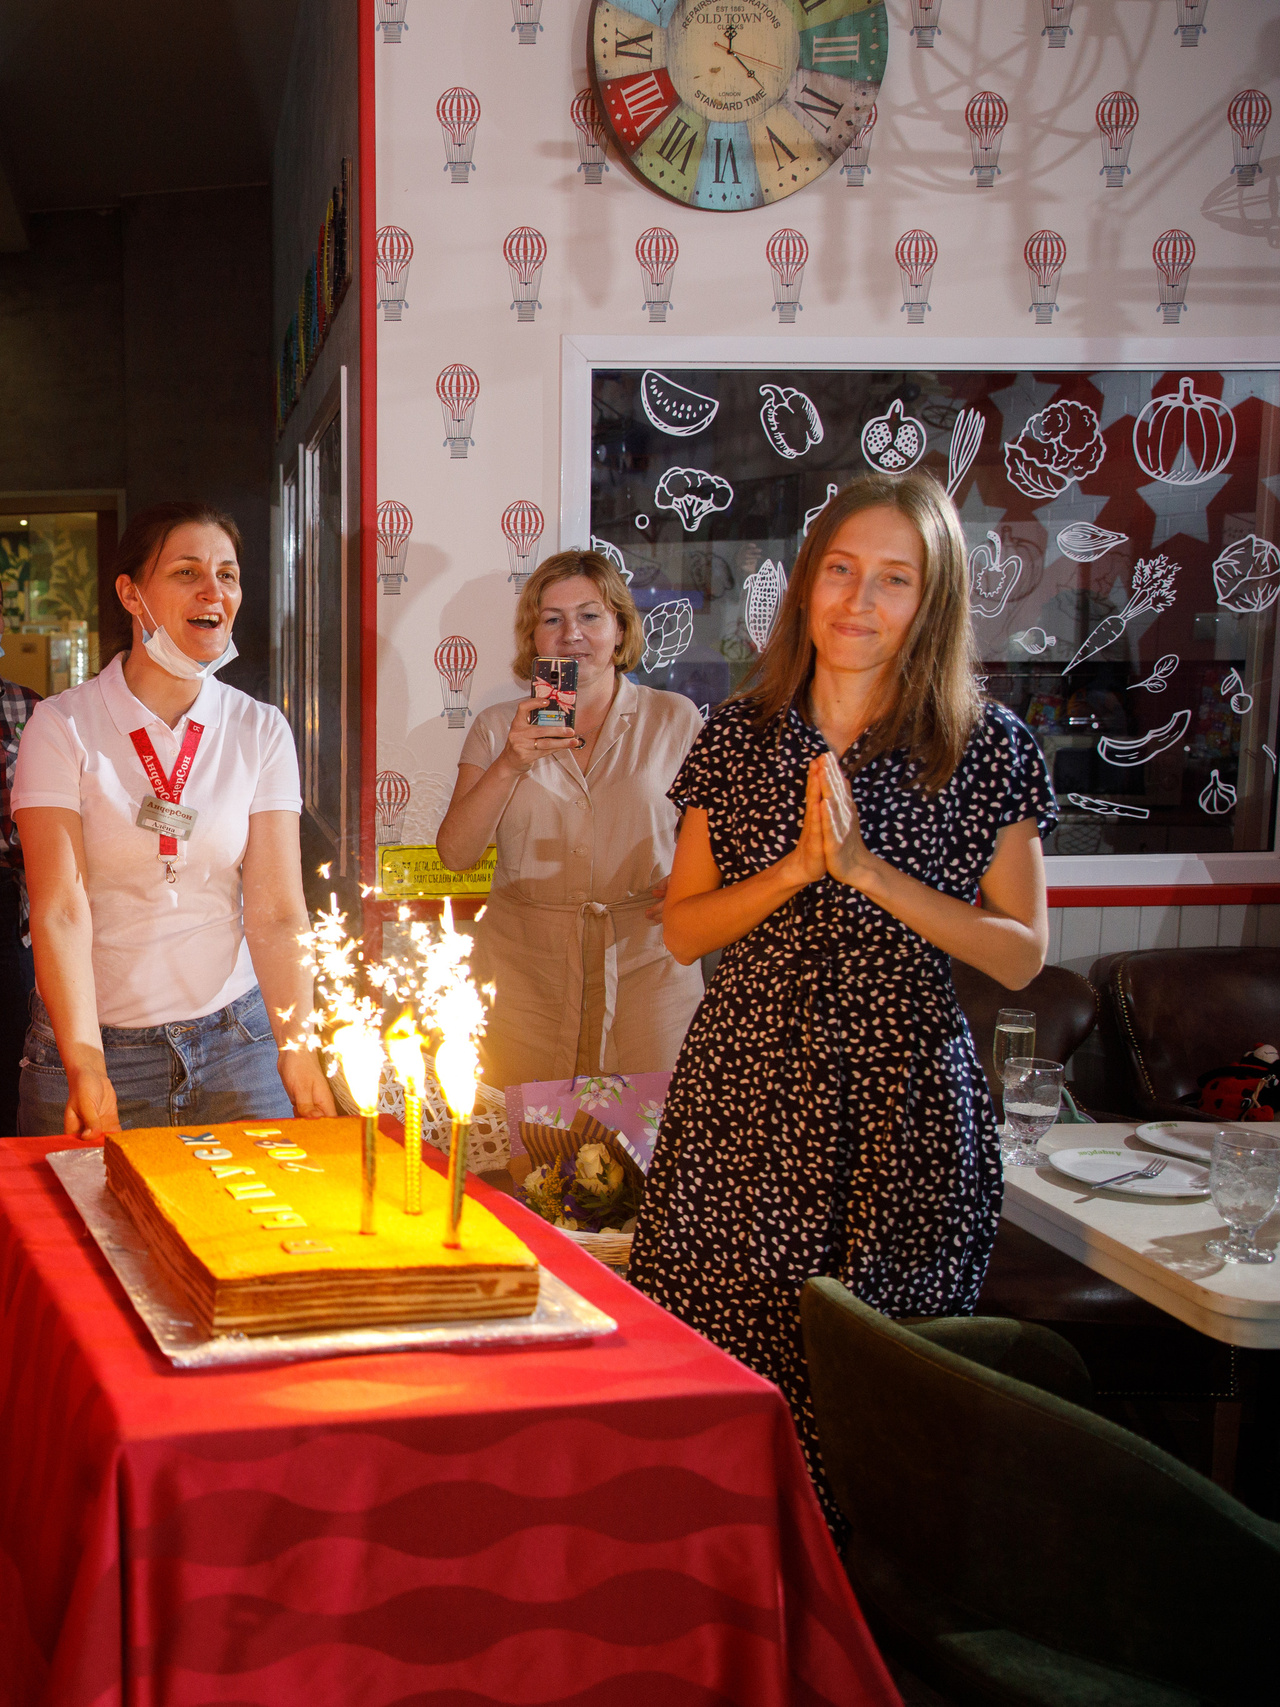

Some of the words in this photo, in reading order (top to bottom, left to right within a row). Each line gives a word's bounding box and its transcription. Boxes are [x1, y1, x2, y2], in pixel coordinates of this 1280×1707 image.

[696, 13, 722, 24] OLD
[724, 12, 762, 23] TOWN
[812, 33, 860, 65] III
[694, 89, 743, 111] STANDARD
[744, 88, 767, 107] TIME
[242, 1127, 325, 1173] 2021
